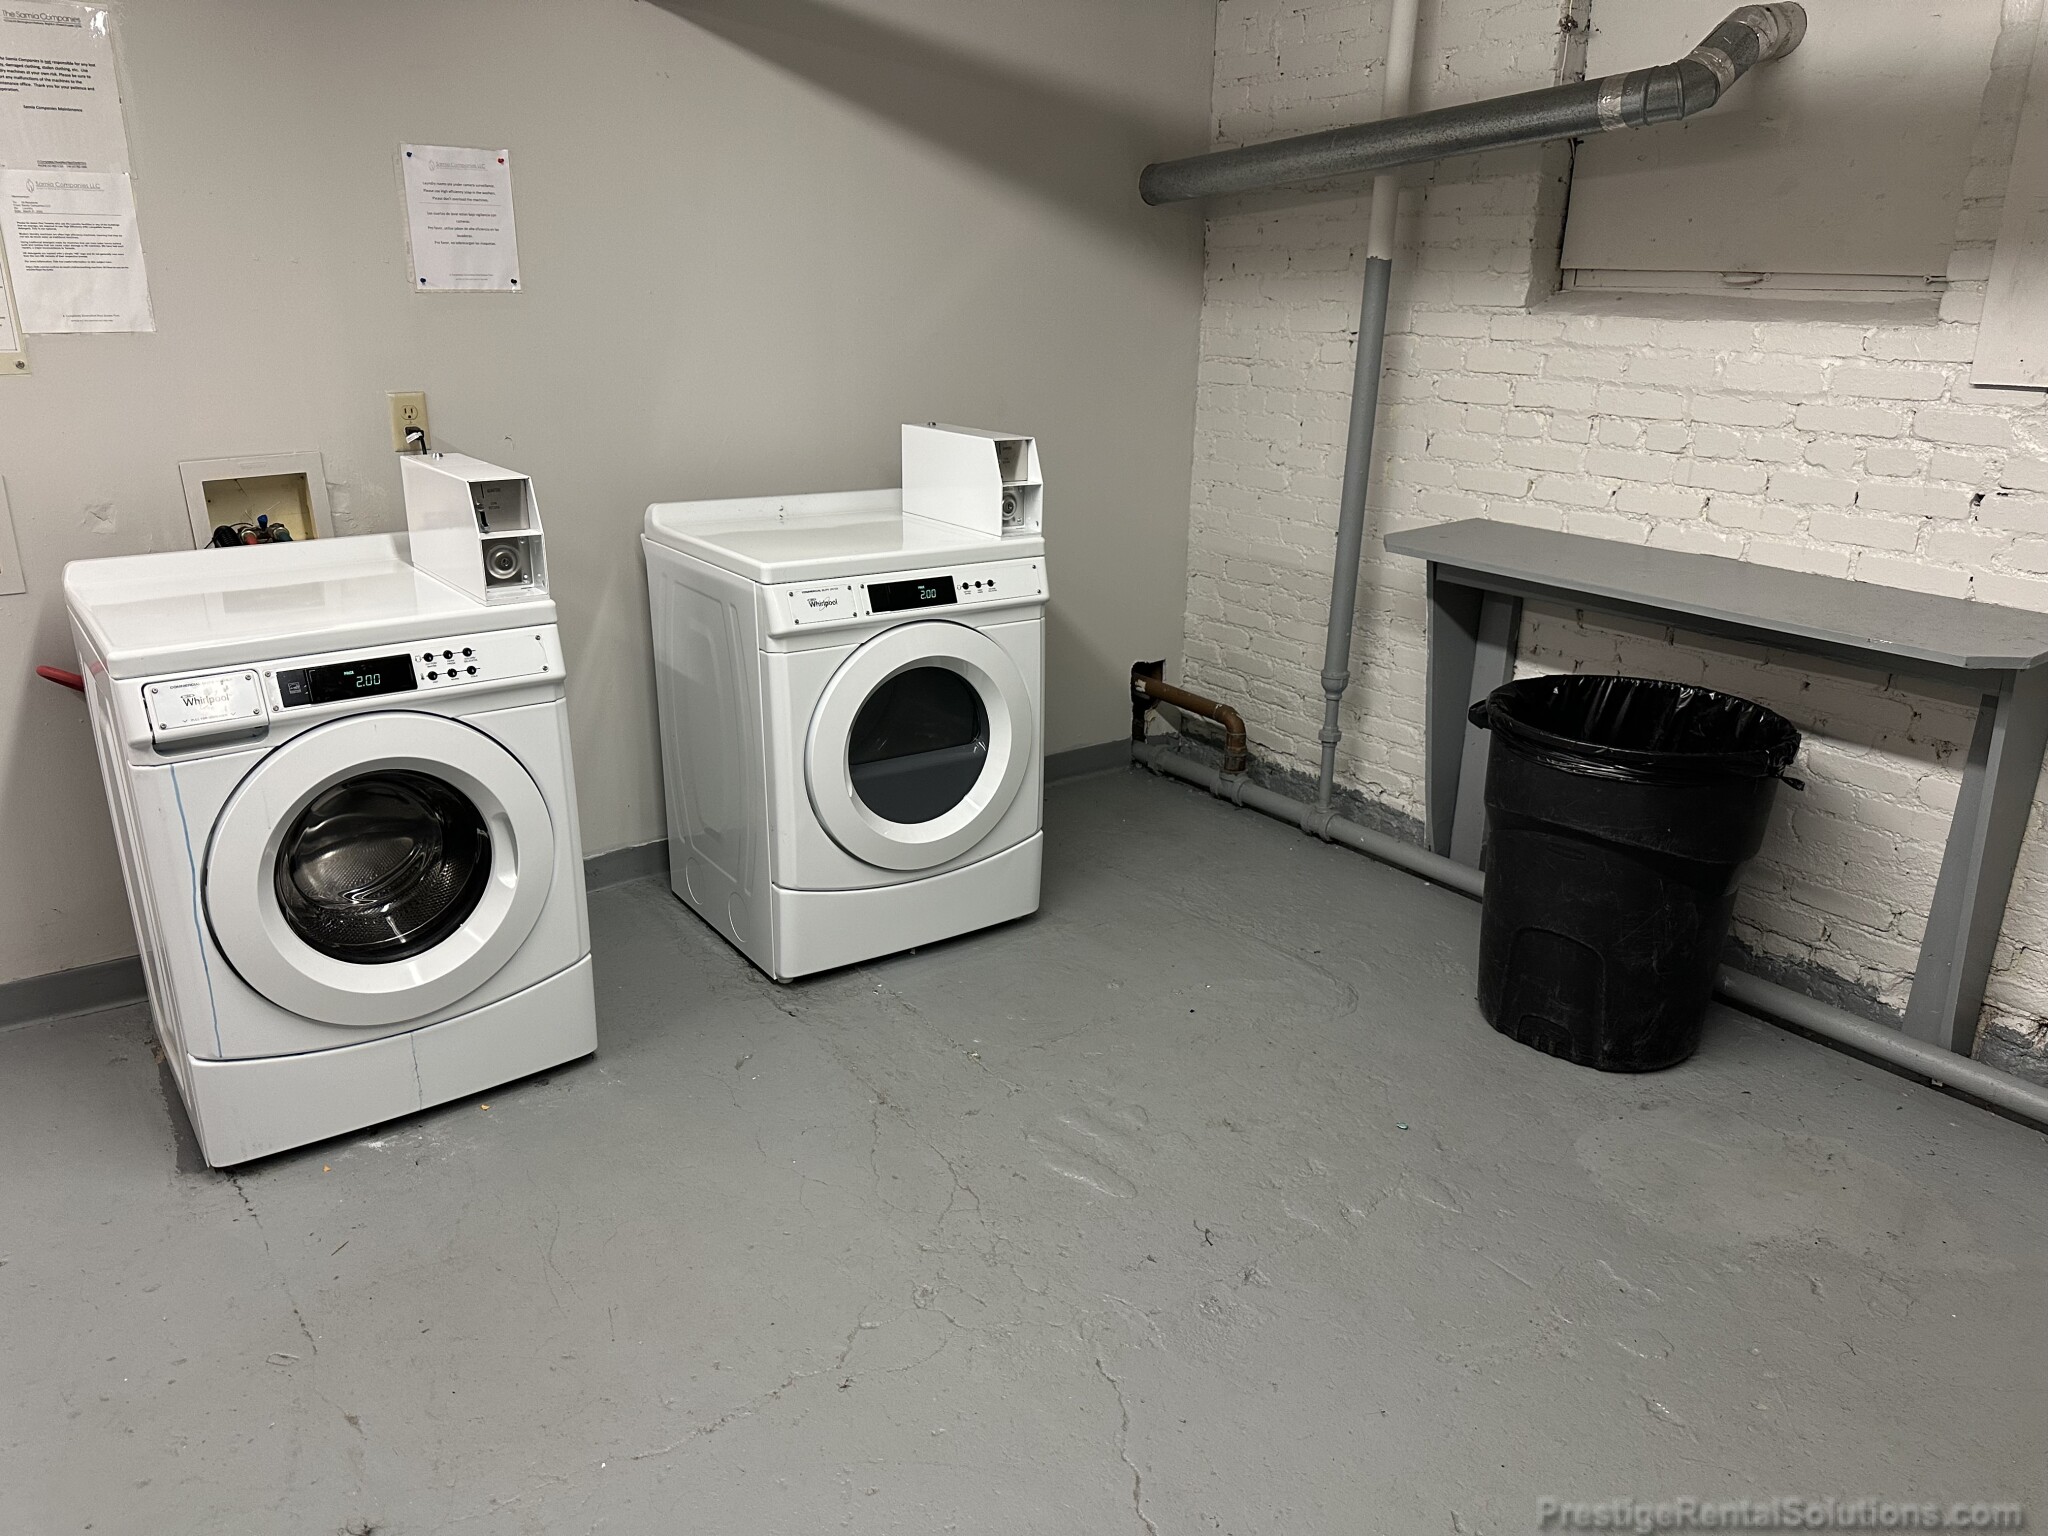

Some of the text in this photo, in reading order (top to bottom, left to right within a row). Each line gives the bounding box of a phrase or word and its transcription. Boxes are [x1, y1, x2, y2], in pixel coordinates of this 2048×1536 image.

[16, 11, 39, 20] Samia
[40, 13, 80, 22] Companies
[920, 588, 937, 600] 2.00
[808, 598, 838, 608] Whirlpool
[356, 673, 381, 688] 2.00
[182, 693, 230, 707] Whirlpool
